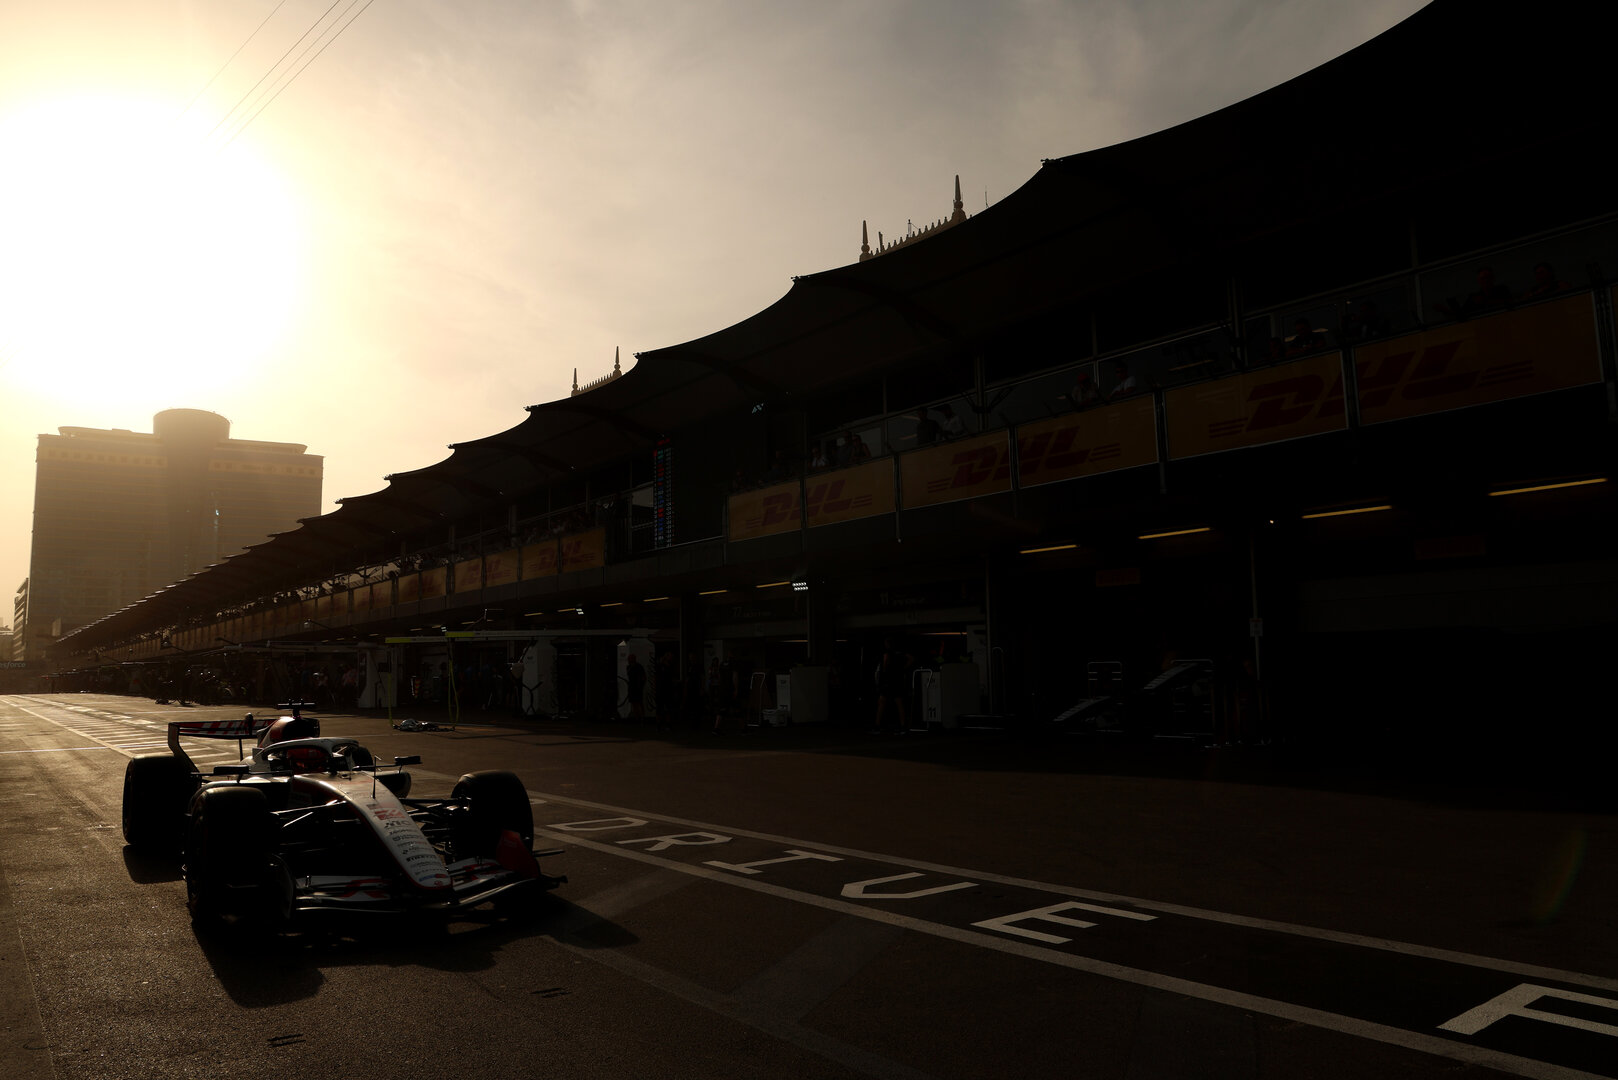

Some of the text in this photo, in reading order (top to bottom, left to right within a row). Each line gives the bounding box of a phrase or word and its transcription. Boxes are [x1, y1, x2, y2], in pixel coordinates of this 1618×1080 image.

[1246, 340, 1481, 432] DHL
[951, 426, 1088, 490] DHL
[761, 480, 853, 526] DHL
[537, 541, 585, 570] DHL
[546, 816, 1159, 945] DRIVE
